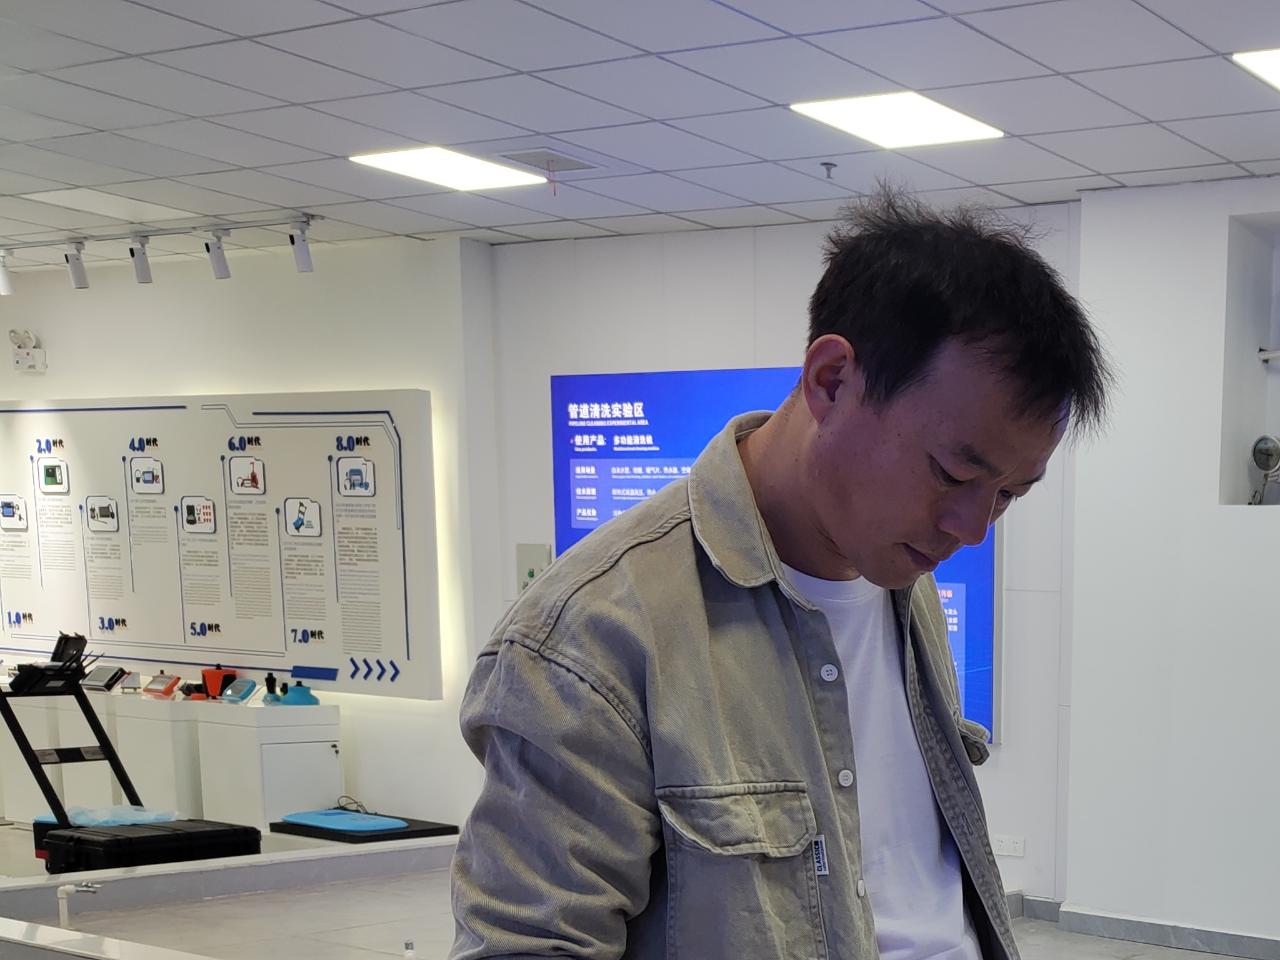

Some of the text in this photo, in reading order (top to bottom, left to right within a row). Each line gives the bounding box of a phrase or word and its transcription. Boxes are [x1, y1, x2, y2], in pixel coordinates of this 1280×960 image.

[568, 402, 645, 419] 管道清洗实验区
